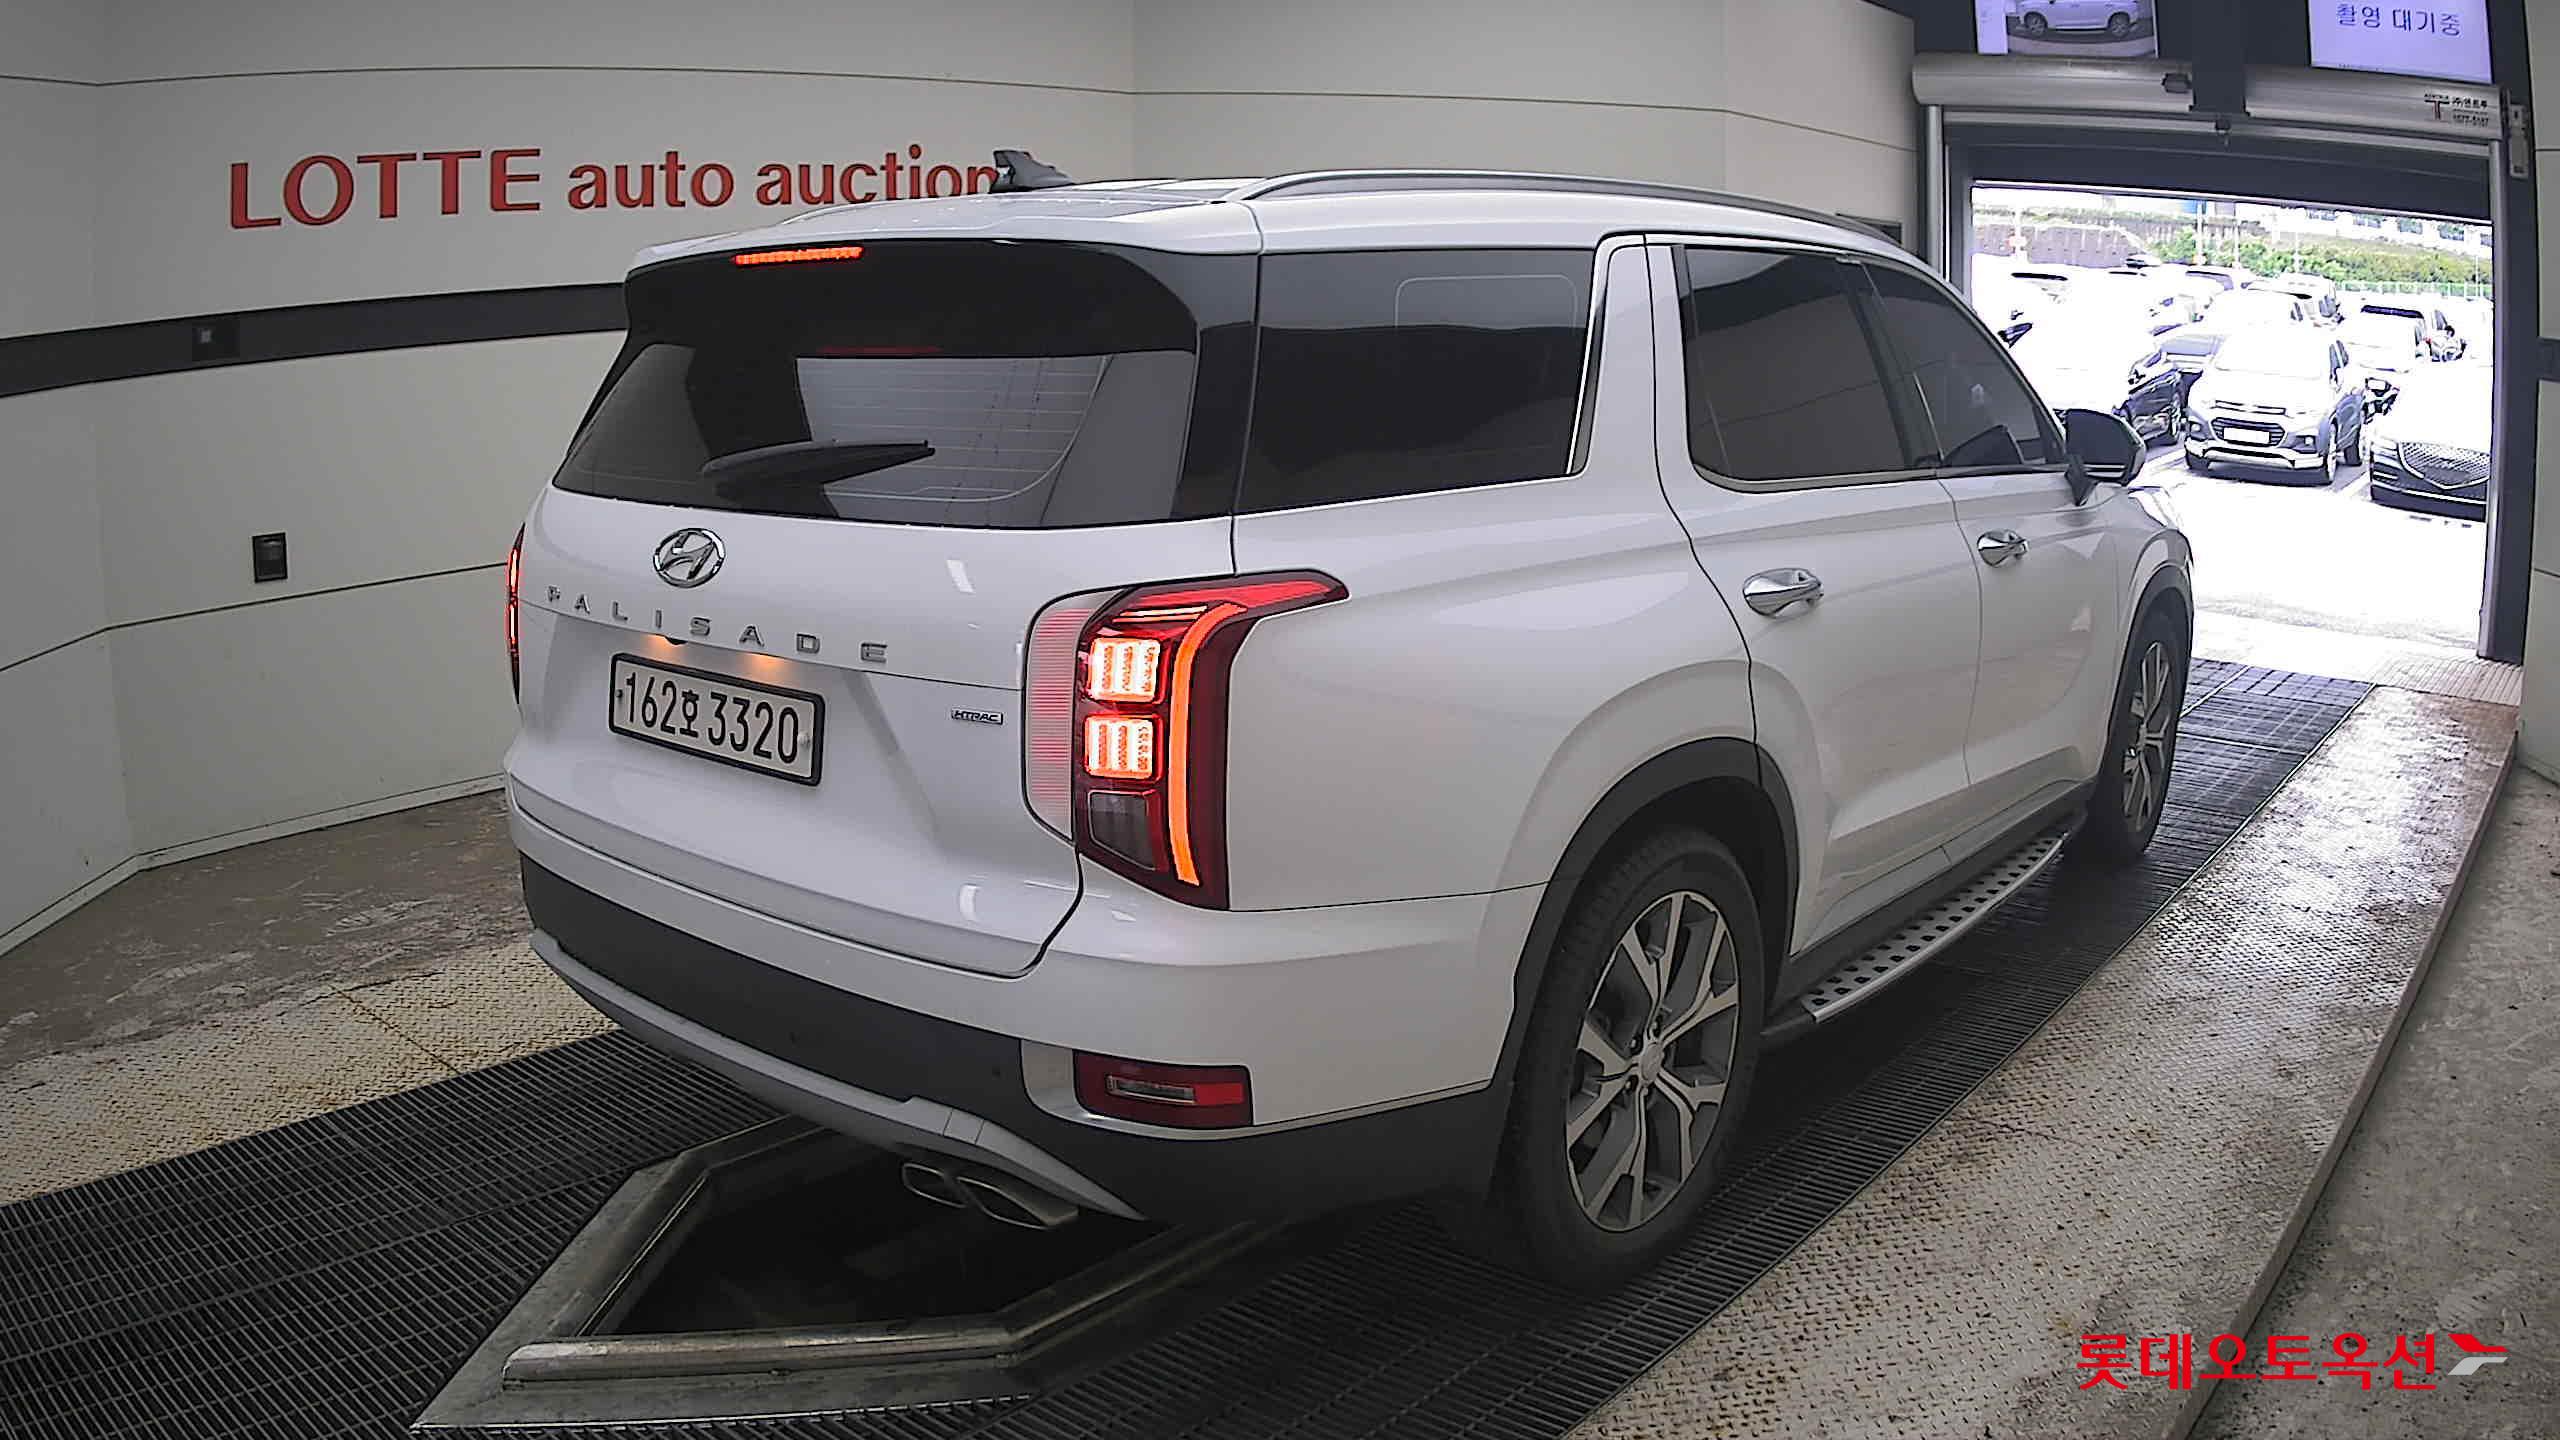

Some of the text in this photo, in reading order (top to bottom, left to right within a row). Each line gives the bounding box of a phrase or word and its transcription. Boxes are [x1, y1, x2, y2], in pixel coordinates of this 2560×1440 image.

[2336, 3, 2461, 37] 촬영 대기중
[230, 143, 1000, 229] LOTTE auto auction
[547, 585, 889, 664] PALISADE
[953, 709, 1002, 724] HTRAC
